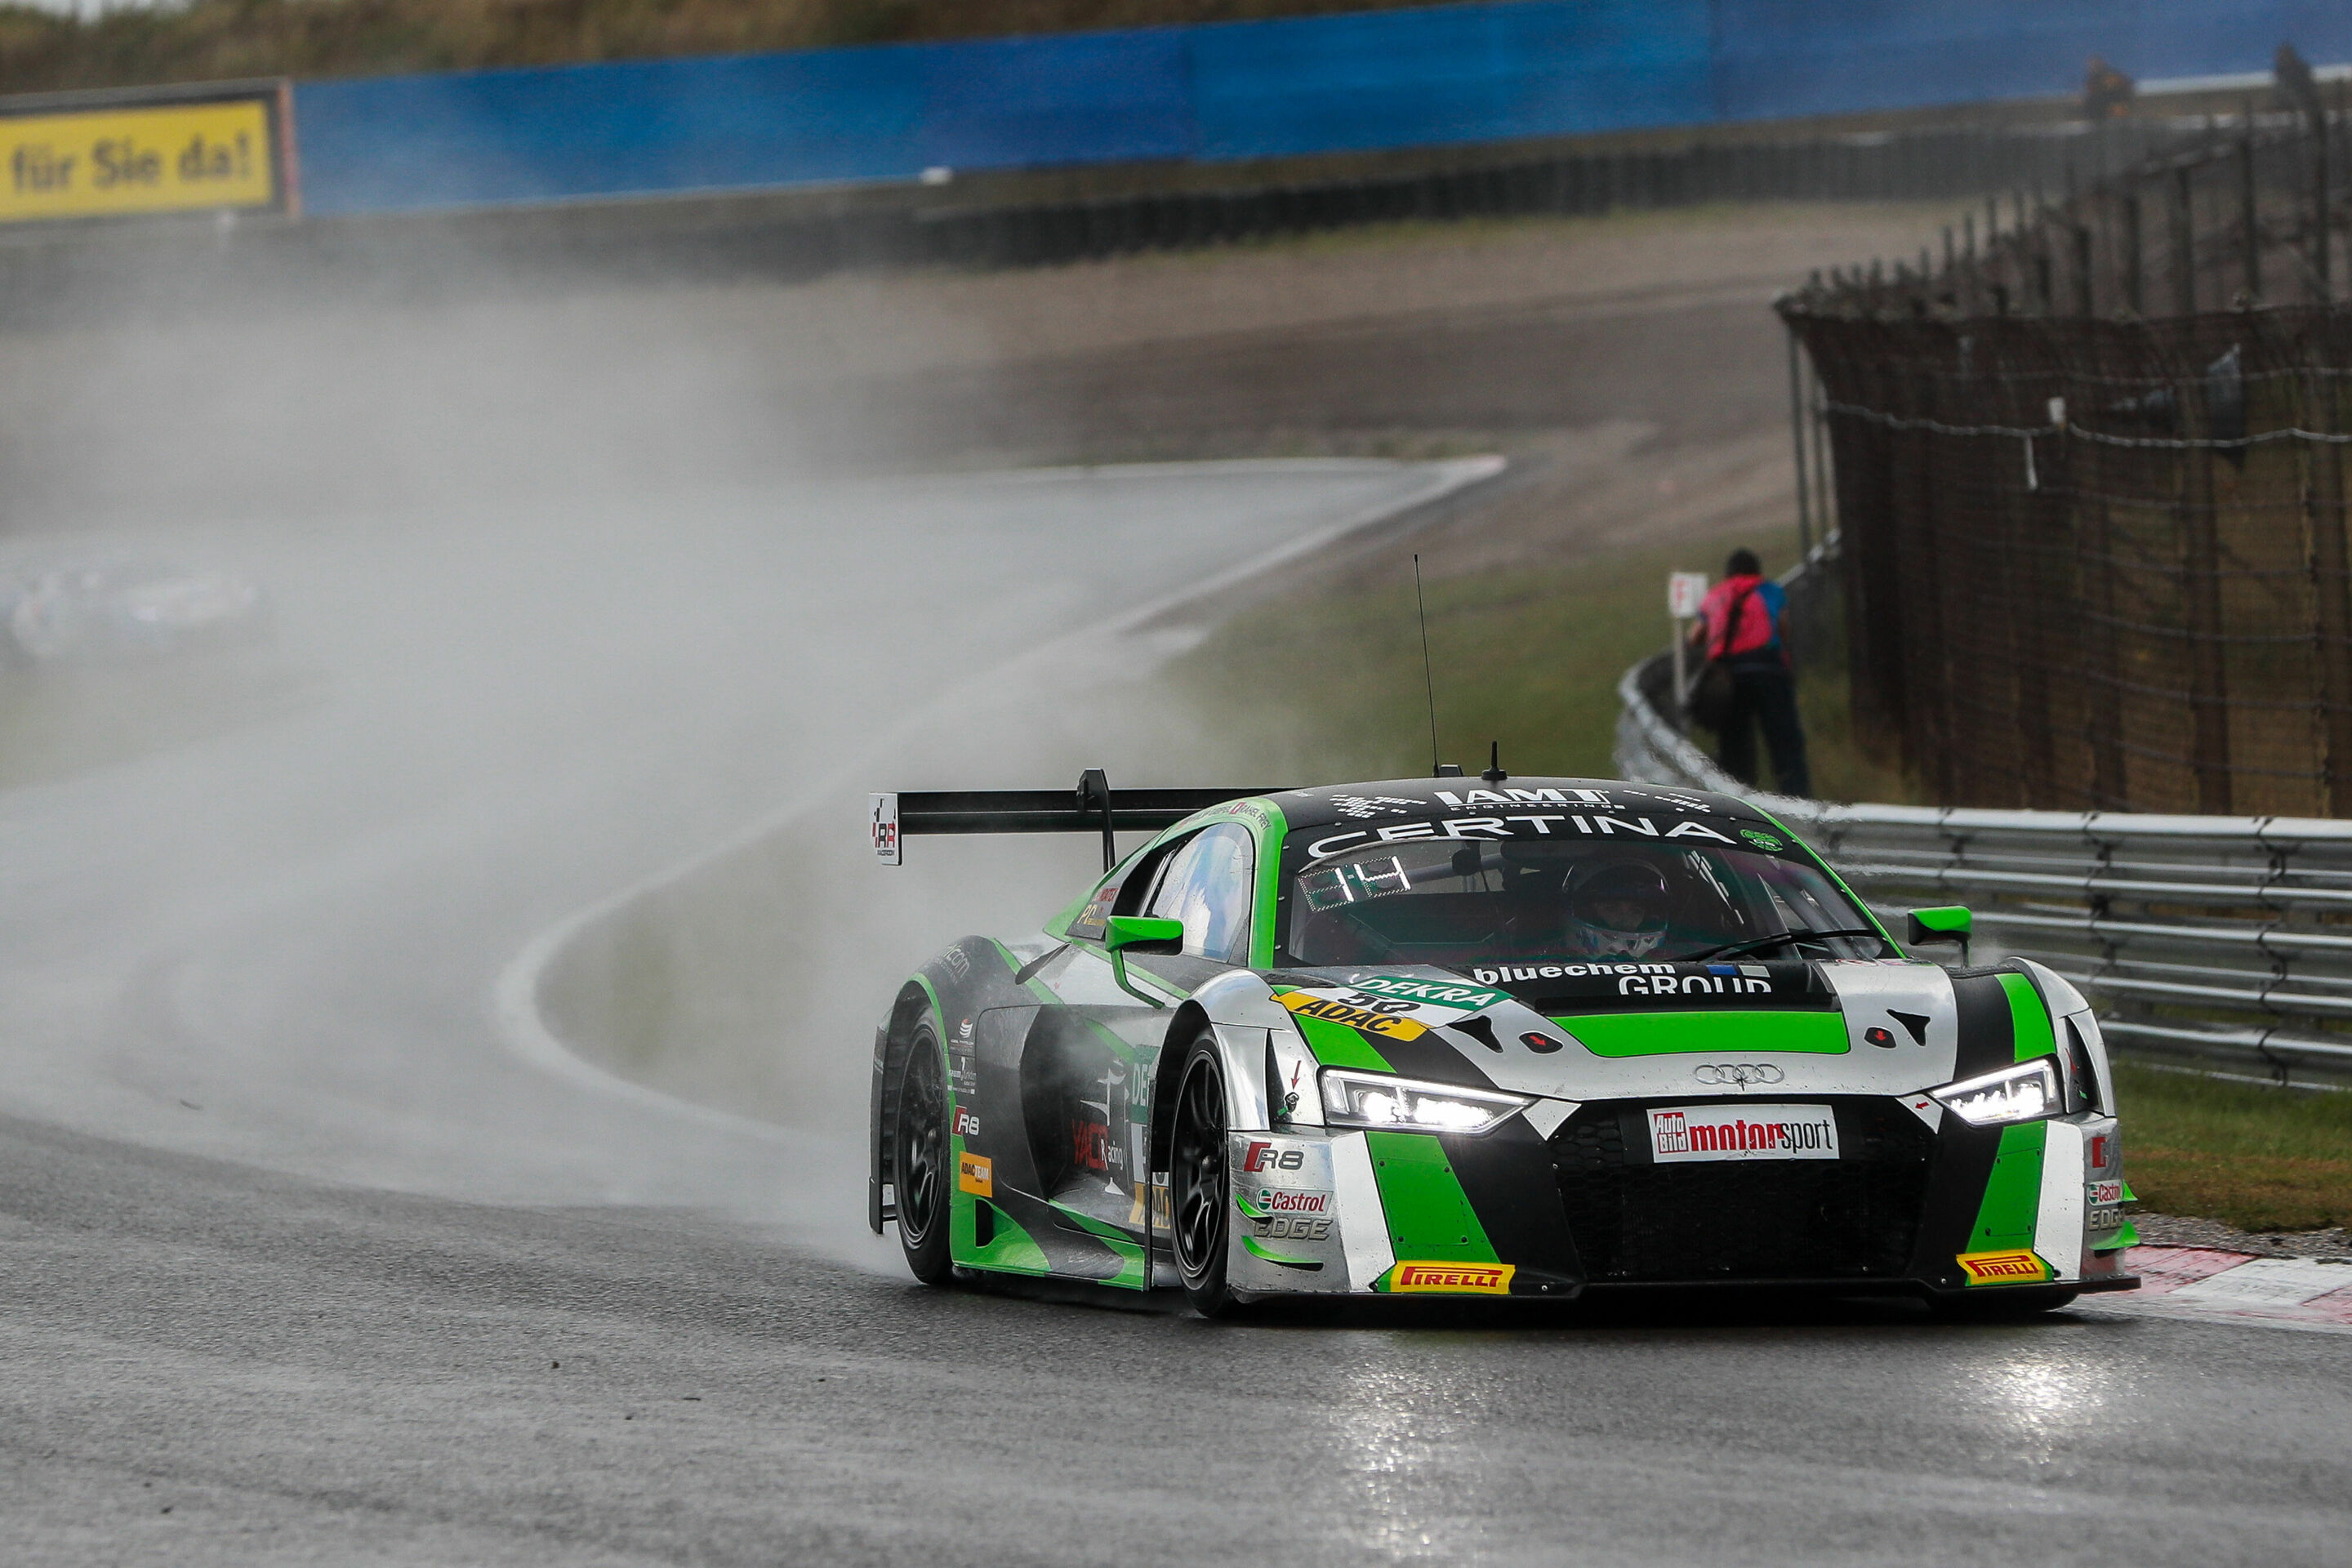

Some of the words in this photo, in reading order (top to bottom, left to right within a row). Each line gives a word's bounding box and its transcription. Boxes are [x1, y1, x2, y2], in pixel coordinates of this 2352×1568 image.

[11, 139, 76, 191] für
[91, 136, 162, 188] Sie
[177, 129, 251, 182] da!
[1307, 816, 1736, 858] CERTINA
[1473, 963, 1677, 986] bluechem
[1349, 978, 1496, 1008] DEKRA
[1294, 1000, 1402, 1032] ADAC
[956, 1111, 980, 1136] R8
[1252, 1147, 1304, 1171] R8
[1272, 1192, 1326, 1212] Castrol
[1254, 1217, 1334, 1241] EDGE
[1401, 1266, 1503, 1287] PIRELLI
[1965, 1255, 2039, 1277] PIRELLI
